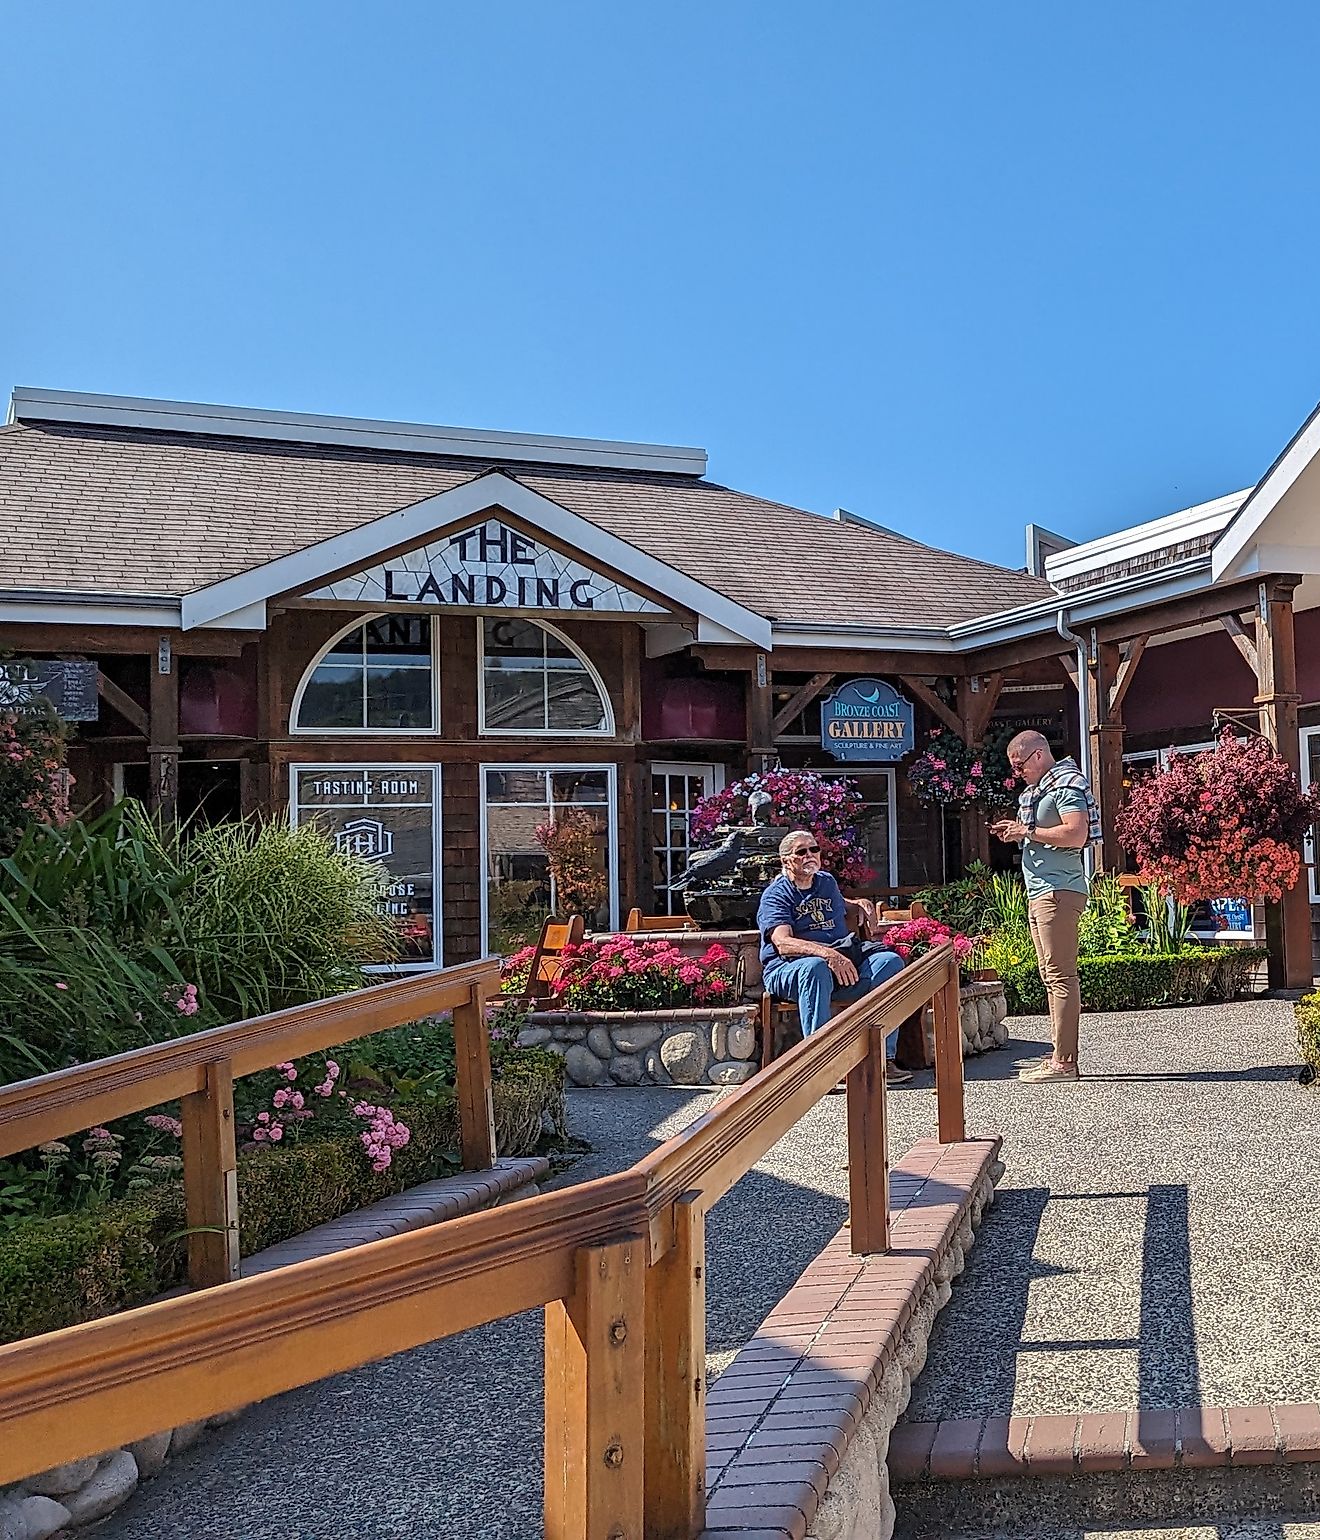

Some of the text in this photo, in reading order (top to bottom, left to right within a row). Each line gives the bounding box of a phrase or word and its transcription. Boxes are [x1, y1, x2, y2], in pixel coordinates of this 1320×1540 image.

[450, 525, 535, 565] THE
[385, 571, 593, 608] LANDING
[834, 701, 900, 717] BRONZE COAST
[828, 721, 906, 739] GALLERY
[313, 780, 418, 795] TASTING ROOM
